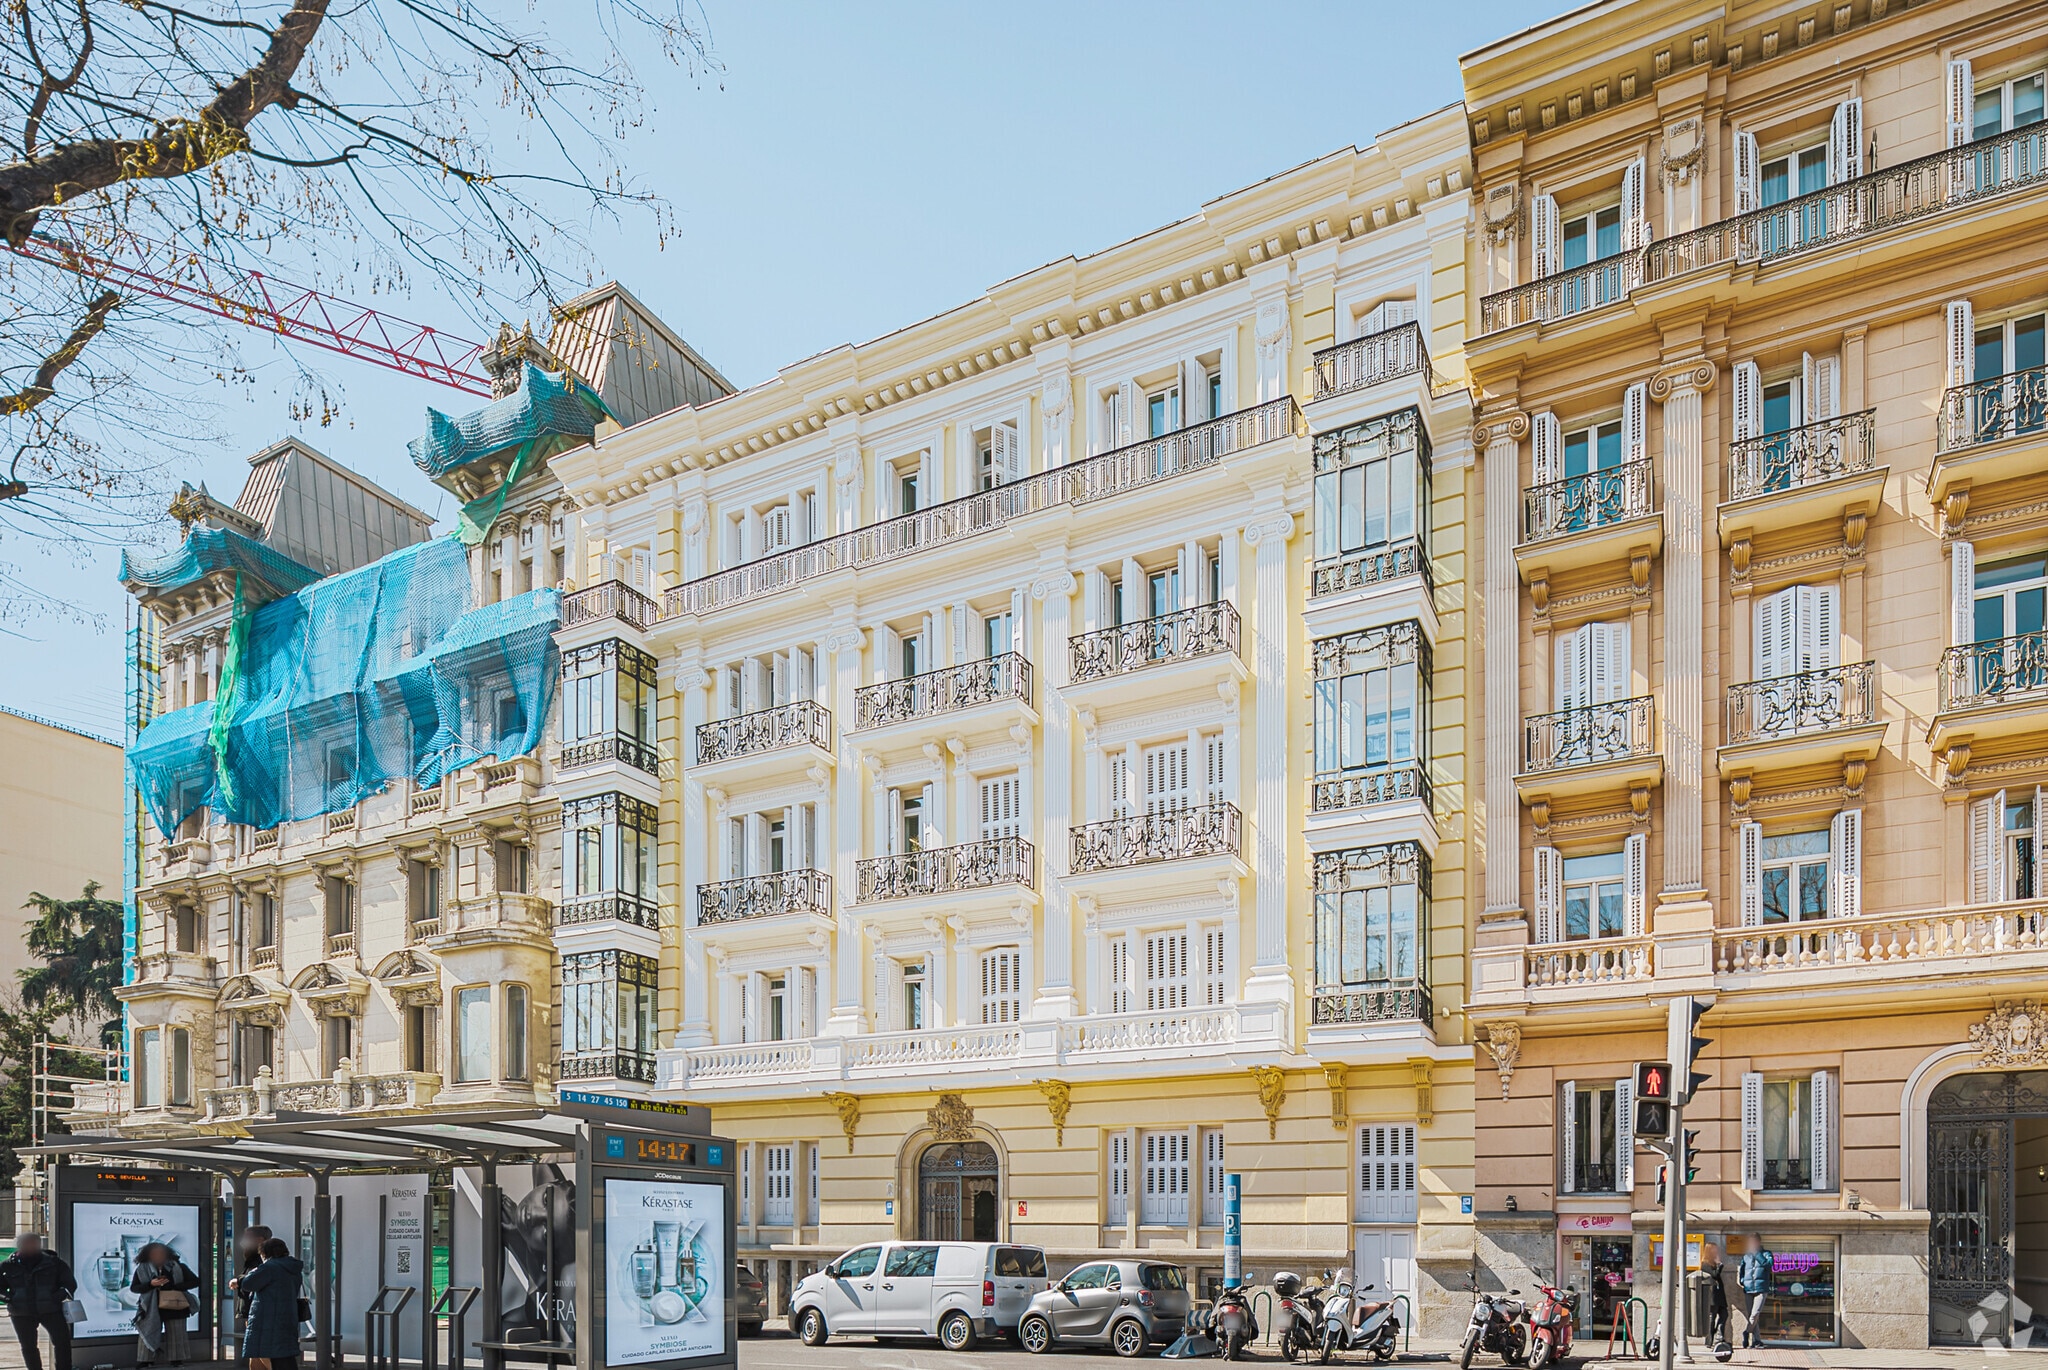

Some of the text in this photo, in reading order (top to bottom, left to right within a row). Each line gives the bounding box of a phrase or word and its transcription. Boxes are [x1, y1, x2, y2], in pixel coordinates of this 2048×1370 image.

[566, 1092, 571, 1100] 5
[578, 1094, 587, 1102] 14
[591, 1096, 600, 1104] 27
[604, 1097, 613, 1105] 45
[616, 1098, 627, 1107] 150
[638, 1139, 689, 1160] 14:17
[654, 1172, 682, 1180] JCDecaux
[392, 1187, 417, 1198] KÉRASTASE
[642, 1195, 693, 1208] KÉRASTASE
[109, 1216, 164, 1226] KÉRASTASE
[391, 1219, 418, 1227] SYMBIOSE
[1226, 1215, 1235, 1233] P
[650, 1340, 687, 1350] SYMBIOSE
[621, 1351, 645, 1359] CUIDADO
